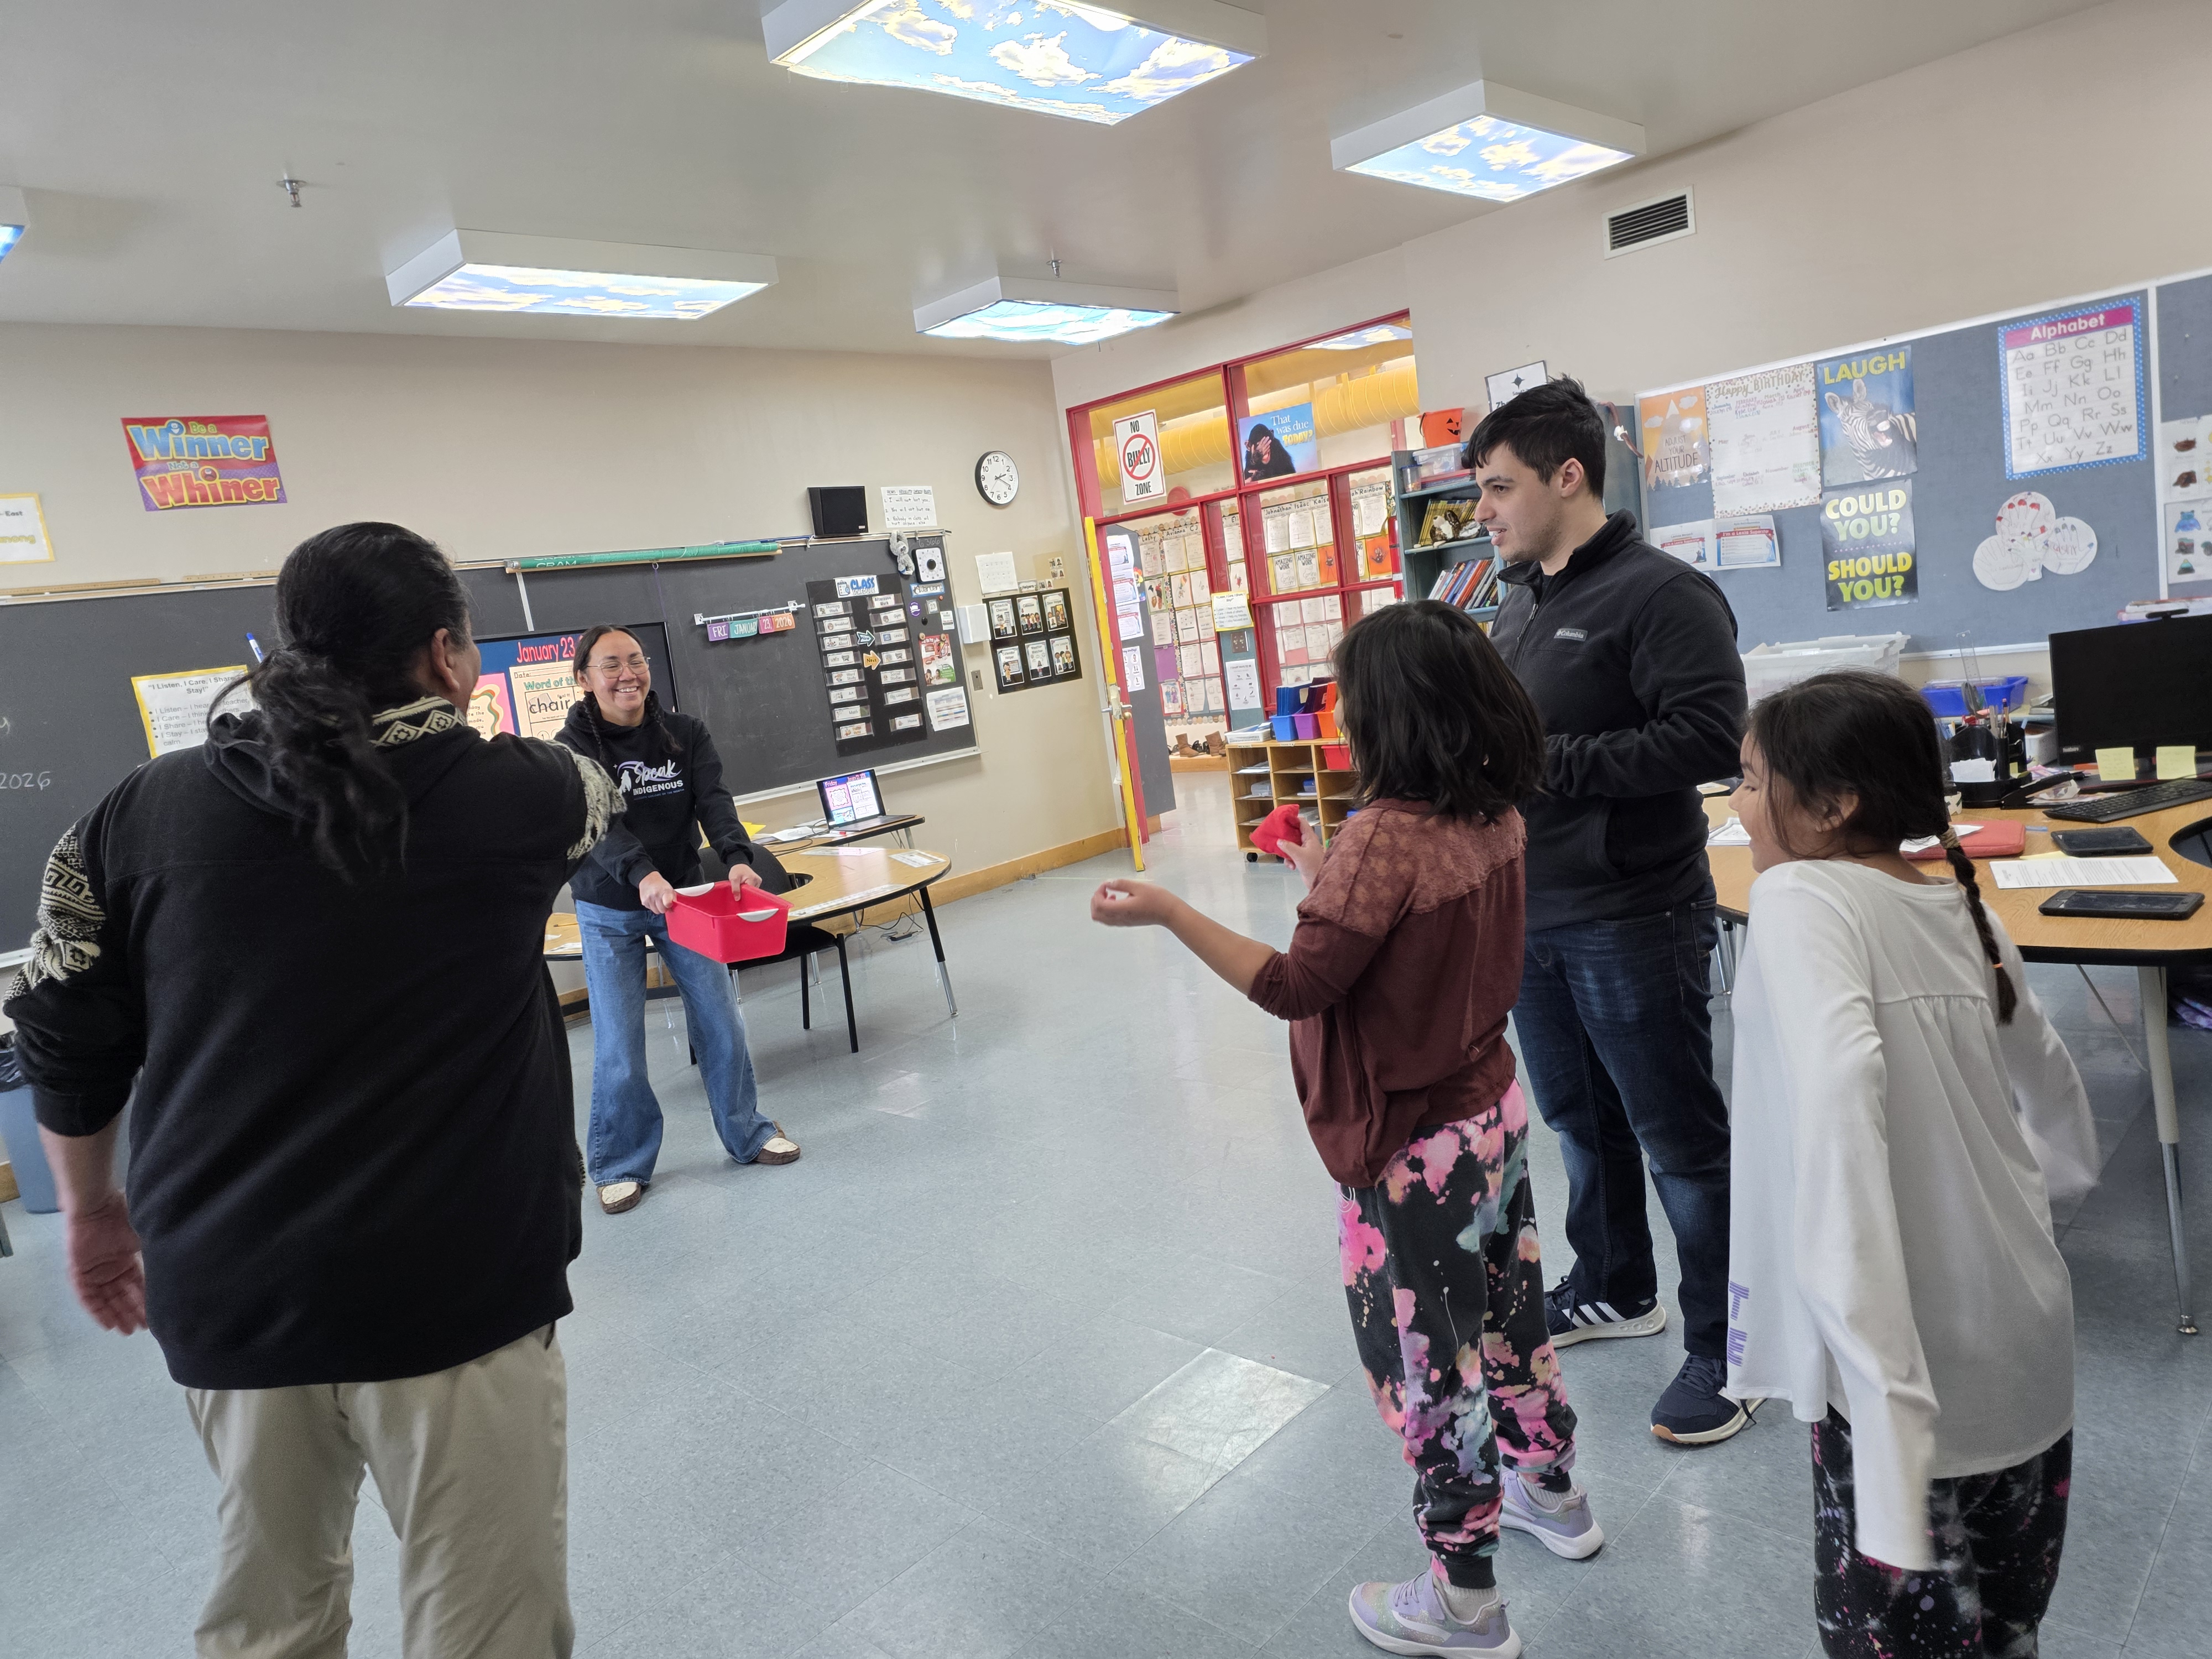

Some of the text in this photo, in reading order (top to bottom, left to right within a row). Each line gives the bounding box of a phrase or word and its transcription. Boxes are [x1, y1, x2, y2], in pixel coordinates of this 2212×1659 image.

[2031, 313, 2105, 340] Alphabet
[2012, 327, 2126, 364] Aa Bb Cc Dd
[1824, 351, 1905, 384] LAUGH
[2016, 347, 2126, 380] Ee Ff Gg Hh
[1715, 370, 1804, 399] Happy BIRTHDAY
[2023, 366, 2120, 398] Ii Jj Kk Ll
[2025, 386, 2121, 414] Mm Nn Oo
[189, 421, 217, 433] Be a
[1130, 420, 1140, 434] NO
[1271, 415, 1291, 426] That
[1276, 421, 1309, 434] was due
[2020, 403, 2127, 436] Pp Qq Rr Ss
[127, 419, 269, 461] Winner
[1282, 430, 1313, 447] TODAY?
[1665, 435, 1686, 447] ADJUST
[2016, 420, 2132, 450] Tt Uu Vv Ww
[1127, 447, 1150, 468] BULLY
[1668, 445, 1684, 455] YOUR
[2036, 441, 2113, 465] Xx Yy Zz
[167, 461, 188, 470] Not
[1655, 452, 1698, 473] ALTITUDE
[140, 466, 280, 509] Whiner
[1135, 481, 1152, 496] ZONE
[1265, 507, 1291, 515] Johnathan
[1825, 489, 1907, 519] COULD
[1833, 513, 1901, 541] YOU?
[1275, 557, 1292, 566] AMAZING
[1828, 552, 1912, 581] SHOULD
[851, 577, 875, 589] CLASS
[852, 587, 875, 596] SCHEDULE
[920, 585, 943, 593] January
[1838, 575, 1905, 602] YOU?
[712, 617, 792, 638] FRI JANUARY 23, 2026
[1561, 630, 1584, 639] Columbia
[517, 636, 575, 662] January 23
[156, 681, 182, 689] Listen,
[524, 677, 563, 691] Word of
[529, 696, 571, 714] chair
[0, 771, 50, 791] 2026
[634, 759, 677, 786] Speak
[633, 780, 684, 796] INDIGENOUS
